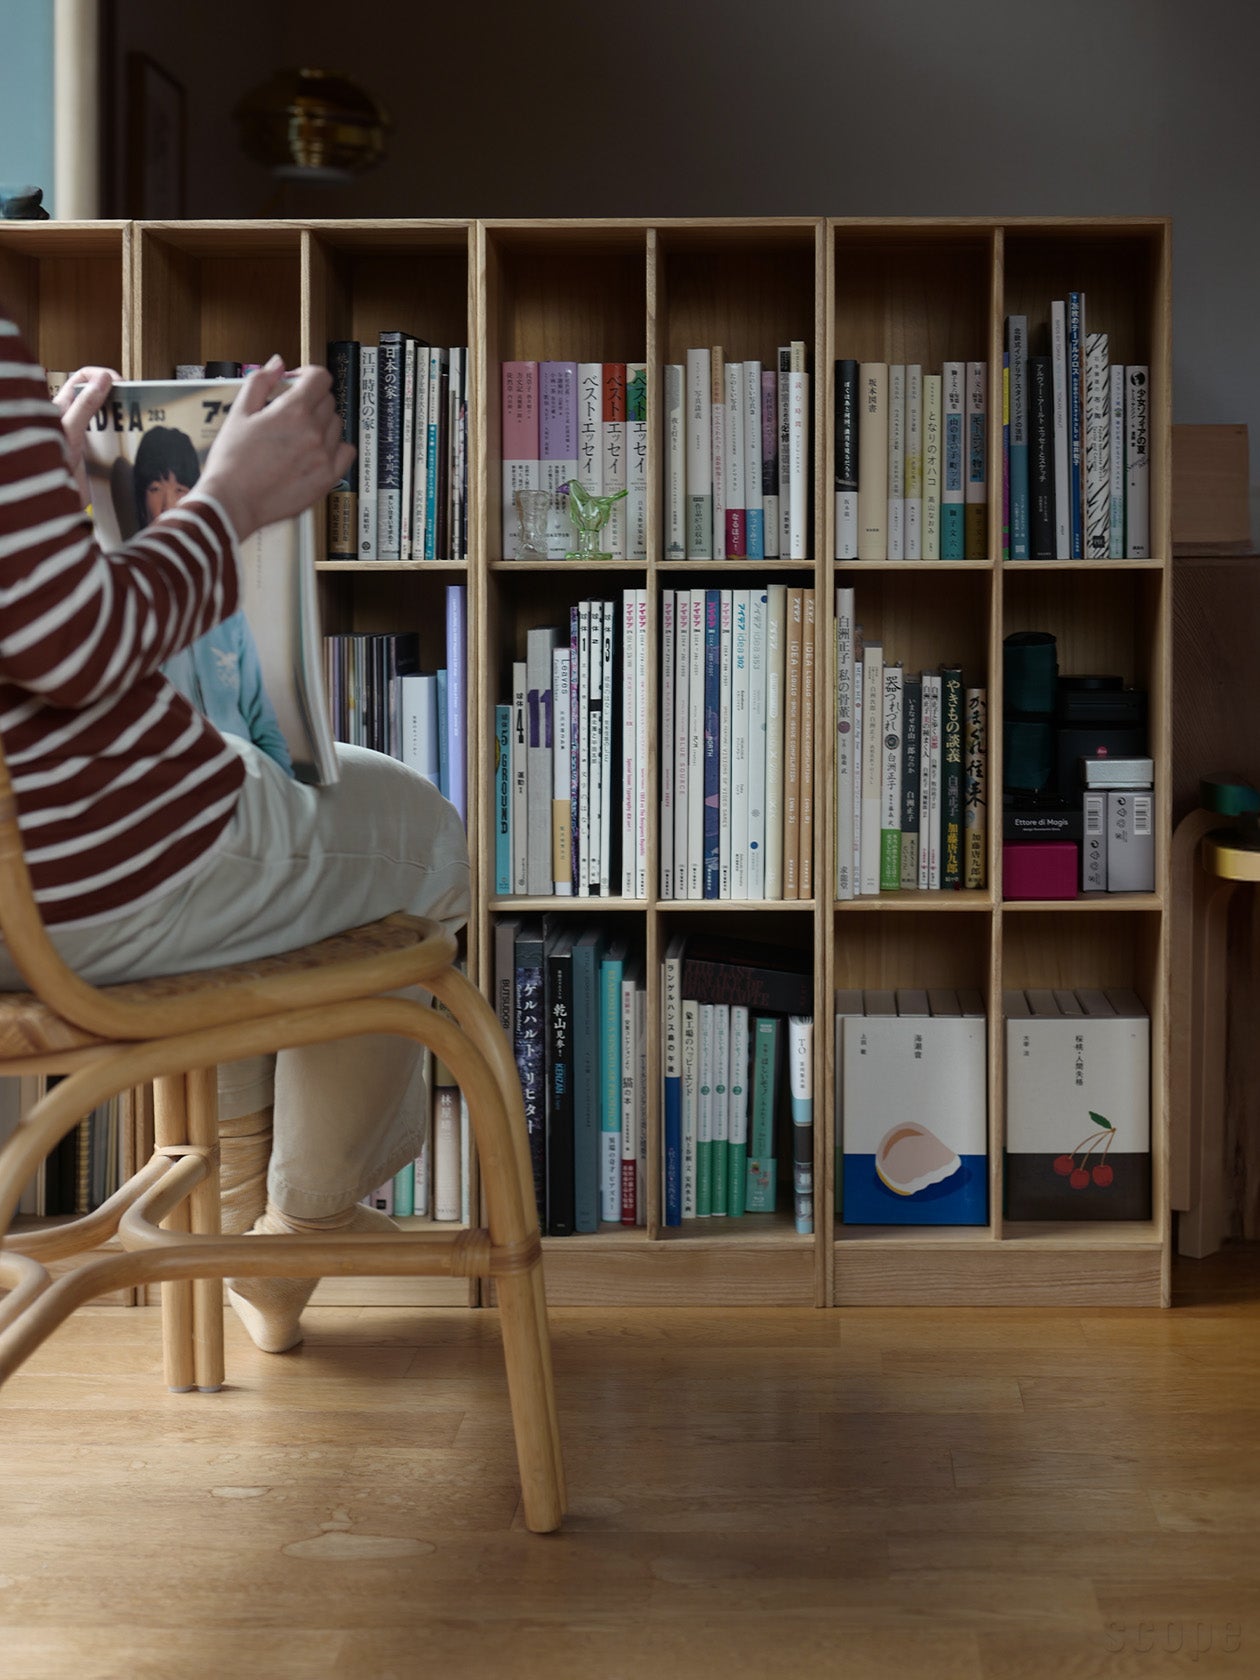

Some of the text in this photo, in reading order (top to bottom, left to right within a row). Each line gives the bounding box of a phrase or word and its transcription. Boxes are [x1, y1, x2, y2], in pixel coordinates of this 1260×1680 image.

[362, 352, 377, 432] 江戸時代の家
[385, 347, 399, 400] 日本の家
[86, 401, 143, 432] DEA
[868, 378, 878, 413] 坂本図書
[582, 375, 599, 474] ベスト・エッセイ
[606, 375, 623, 475] ベスト・エッセイ
[843, 381, 851, 478] ぼくはあと何回、満月を見るだろう
[1136, 388, 1145, 456] 少女ソフィアの夏
[927, 411, 938, 486] となりのオハコ
[737, 603, 745, 631] アイデア
[753, 601, 762, 629] アイデア
[737, 632, 747, 669] idea 302
[753, 630, 763, 670] idea 353
[790, 640, 799, 665] IDEA
[804, 641, 814, 666] IDEA
[838, 615, 850, 664] 白洲正子
[561, 658, 569, 695] Leaves
[527, 689, 551, 748] 11
[907, 698, 916, 774] いまなぜ青山二郎なのか
[946, 680, 961, 763] やきもの談義
[789, 740, 797, 783] COMPILATION
[906, 790, 915, 822] 白洲正子
[948, 776, 958, 817] 白洲正子
[1014, 818, 1069, 828] Ettore di Magis
[667, 964, 675, 1073] ランゲルハンス島の午後
[523, 983, 538, 1134] ゲルハルト・リヒター
[554, 1063, 564, 1095] KENZAN
